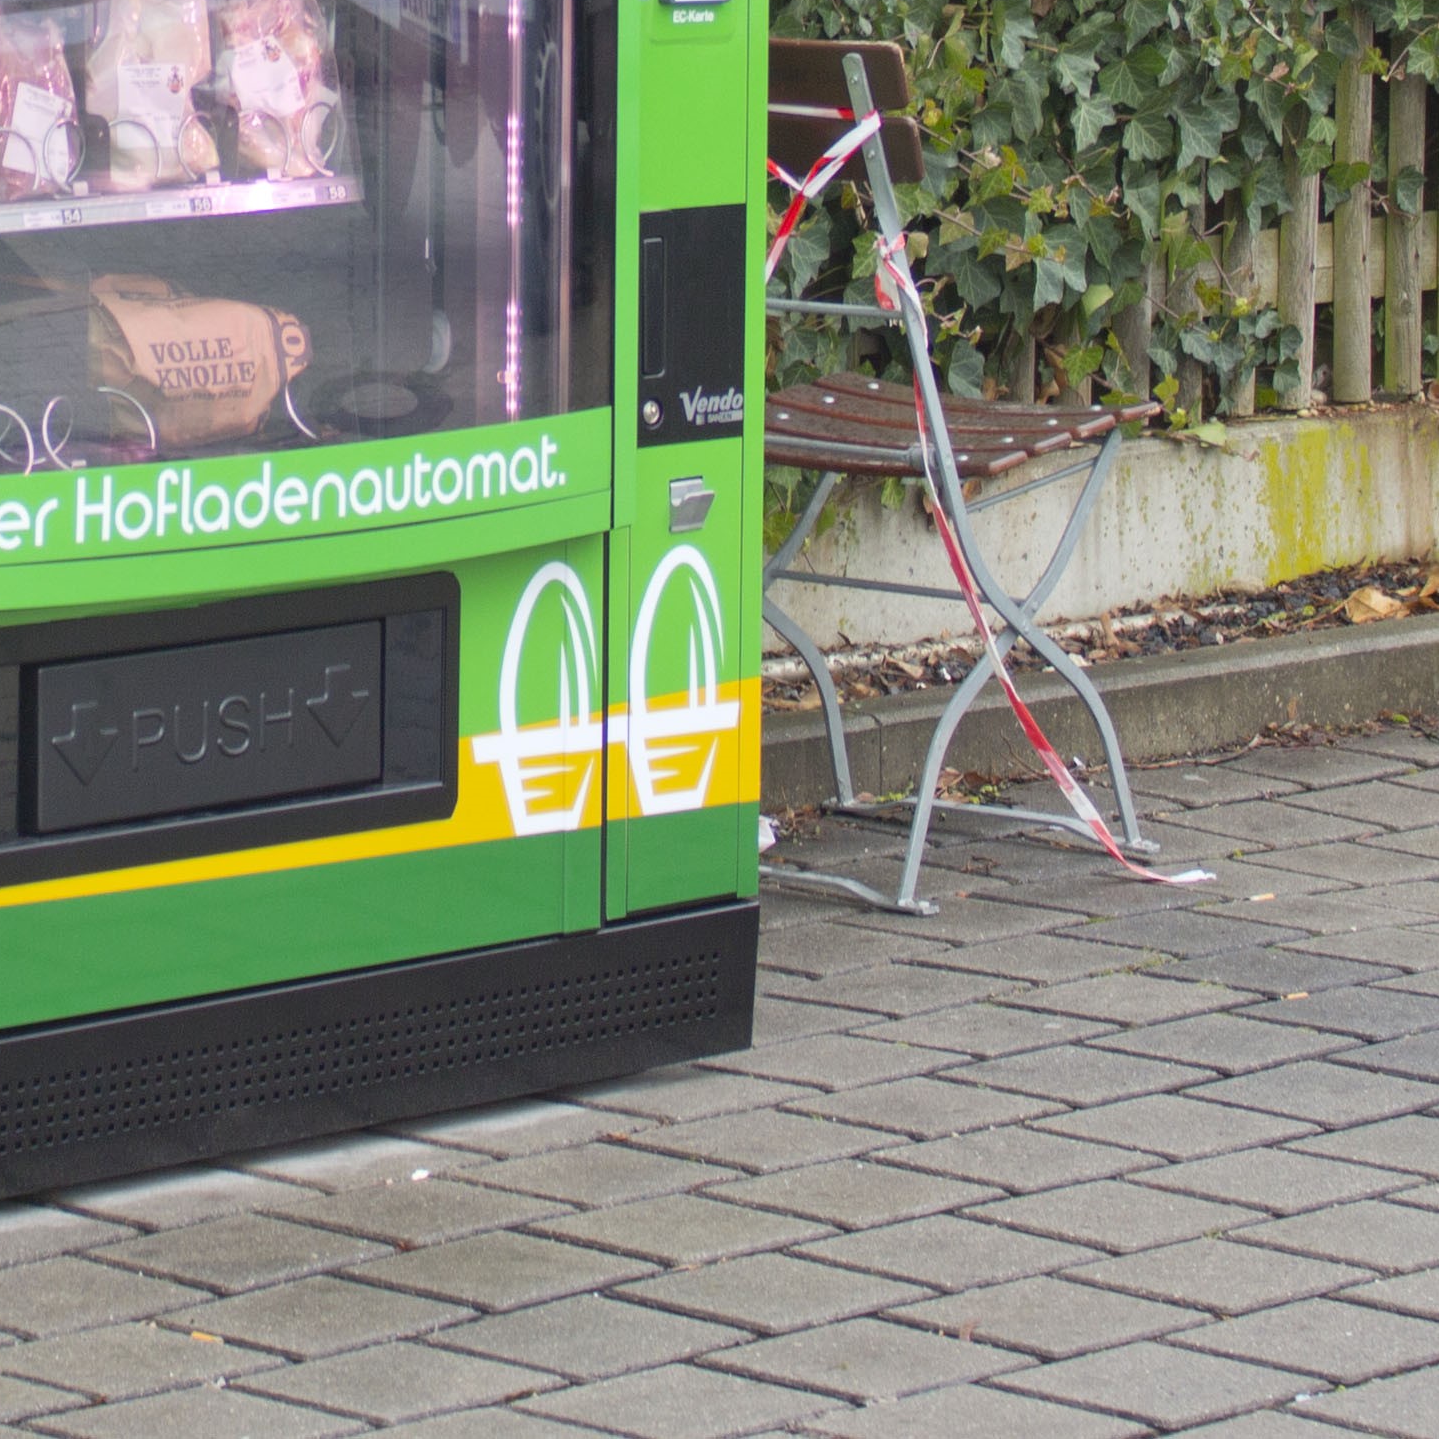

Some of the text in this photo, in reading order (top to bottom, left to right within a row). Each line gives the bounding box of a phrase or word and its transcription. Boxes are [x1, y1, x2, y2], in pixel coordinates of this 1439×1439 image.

[672, 9, 714, 23] EC-Karte
[328, 185, 346, 200] 58
[63, 208, 82, 224] 54
[149, 336, 235, 365] VOLLE
[155, 361, 257, 390] KNOLLE
[679, 386, 744, 422] Vendo
[74, 434, 567, 544] Hofladenautomat.
[132, 687, 294, 772] PUSH
